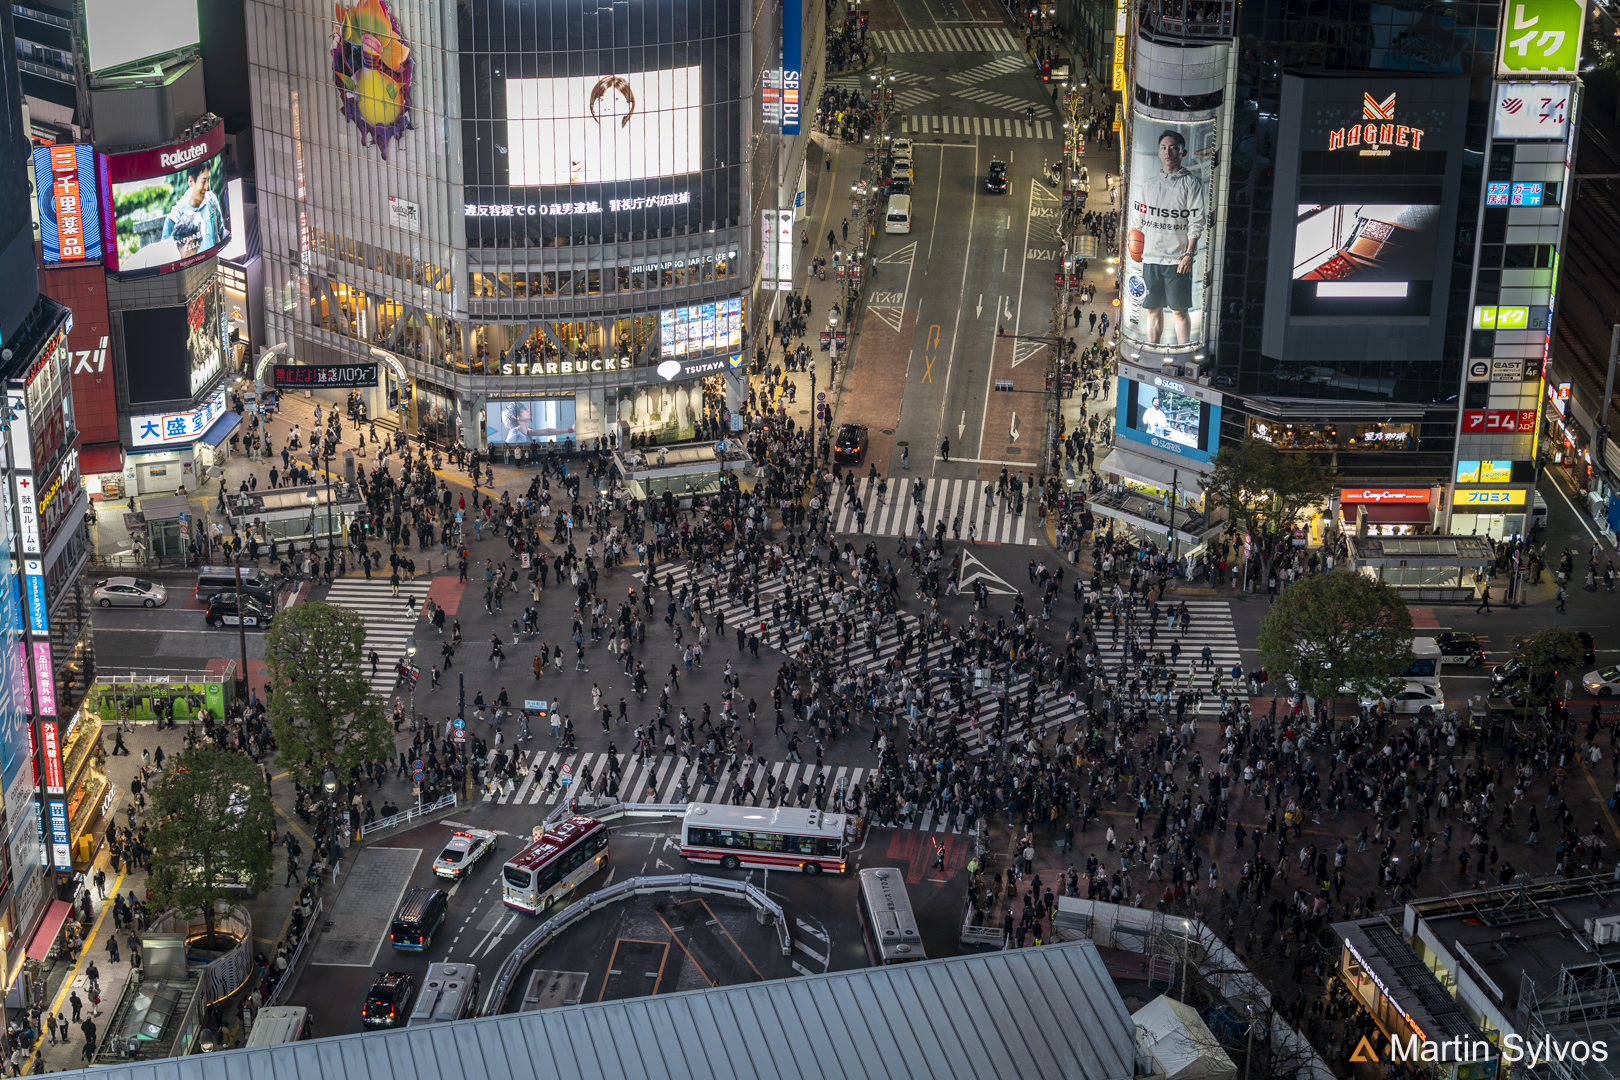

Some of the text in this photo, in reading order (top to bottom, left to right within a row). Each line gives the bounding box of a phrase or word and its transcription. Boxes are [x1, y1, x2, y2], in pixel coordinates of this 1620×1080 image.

[1510, 30, 1565, 56] イク
[1115, 64, 1123, 89] MOM'S
[1328, 123, 1424, 151] MAGNET
[161, 142, 207, 167] Rakuten
[55, 152, 81, 256] 三千里薬品
[1148, 206, 1199, 219] TISSOT
[674, 256, 705, 268] SQARE
[869, 291, 904, 303] バス停
[1482, 309, 1525, 323] レイク
[1532, 318, 1544, 327] 5F
[502, 357, 631, 375] STARBUCKS
[684, 361, 725, 374] TSUTAYA
[1525, 366, 1539, 377] 4F
[1470, 412, 1535, 428] アコム 3F
[1468, 492, 1511, 502] プロミス
[21, 494, 36, 544] 献血ルーム
[38, 655, 52, 704] 品川美容外科
[44, 723, 57, 758] 外貨両替
